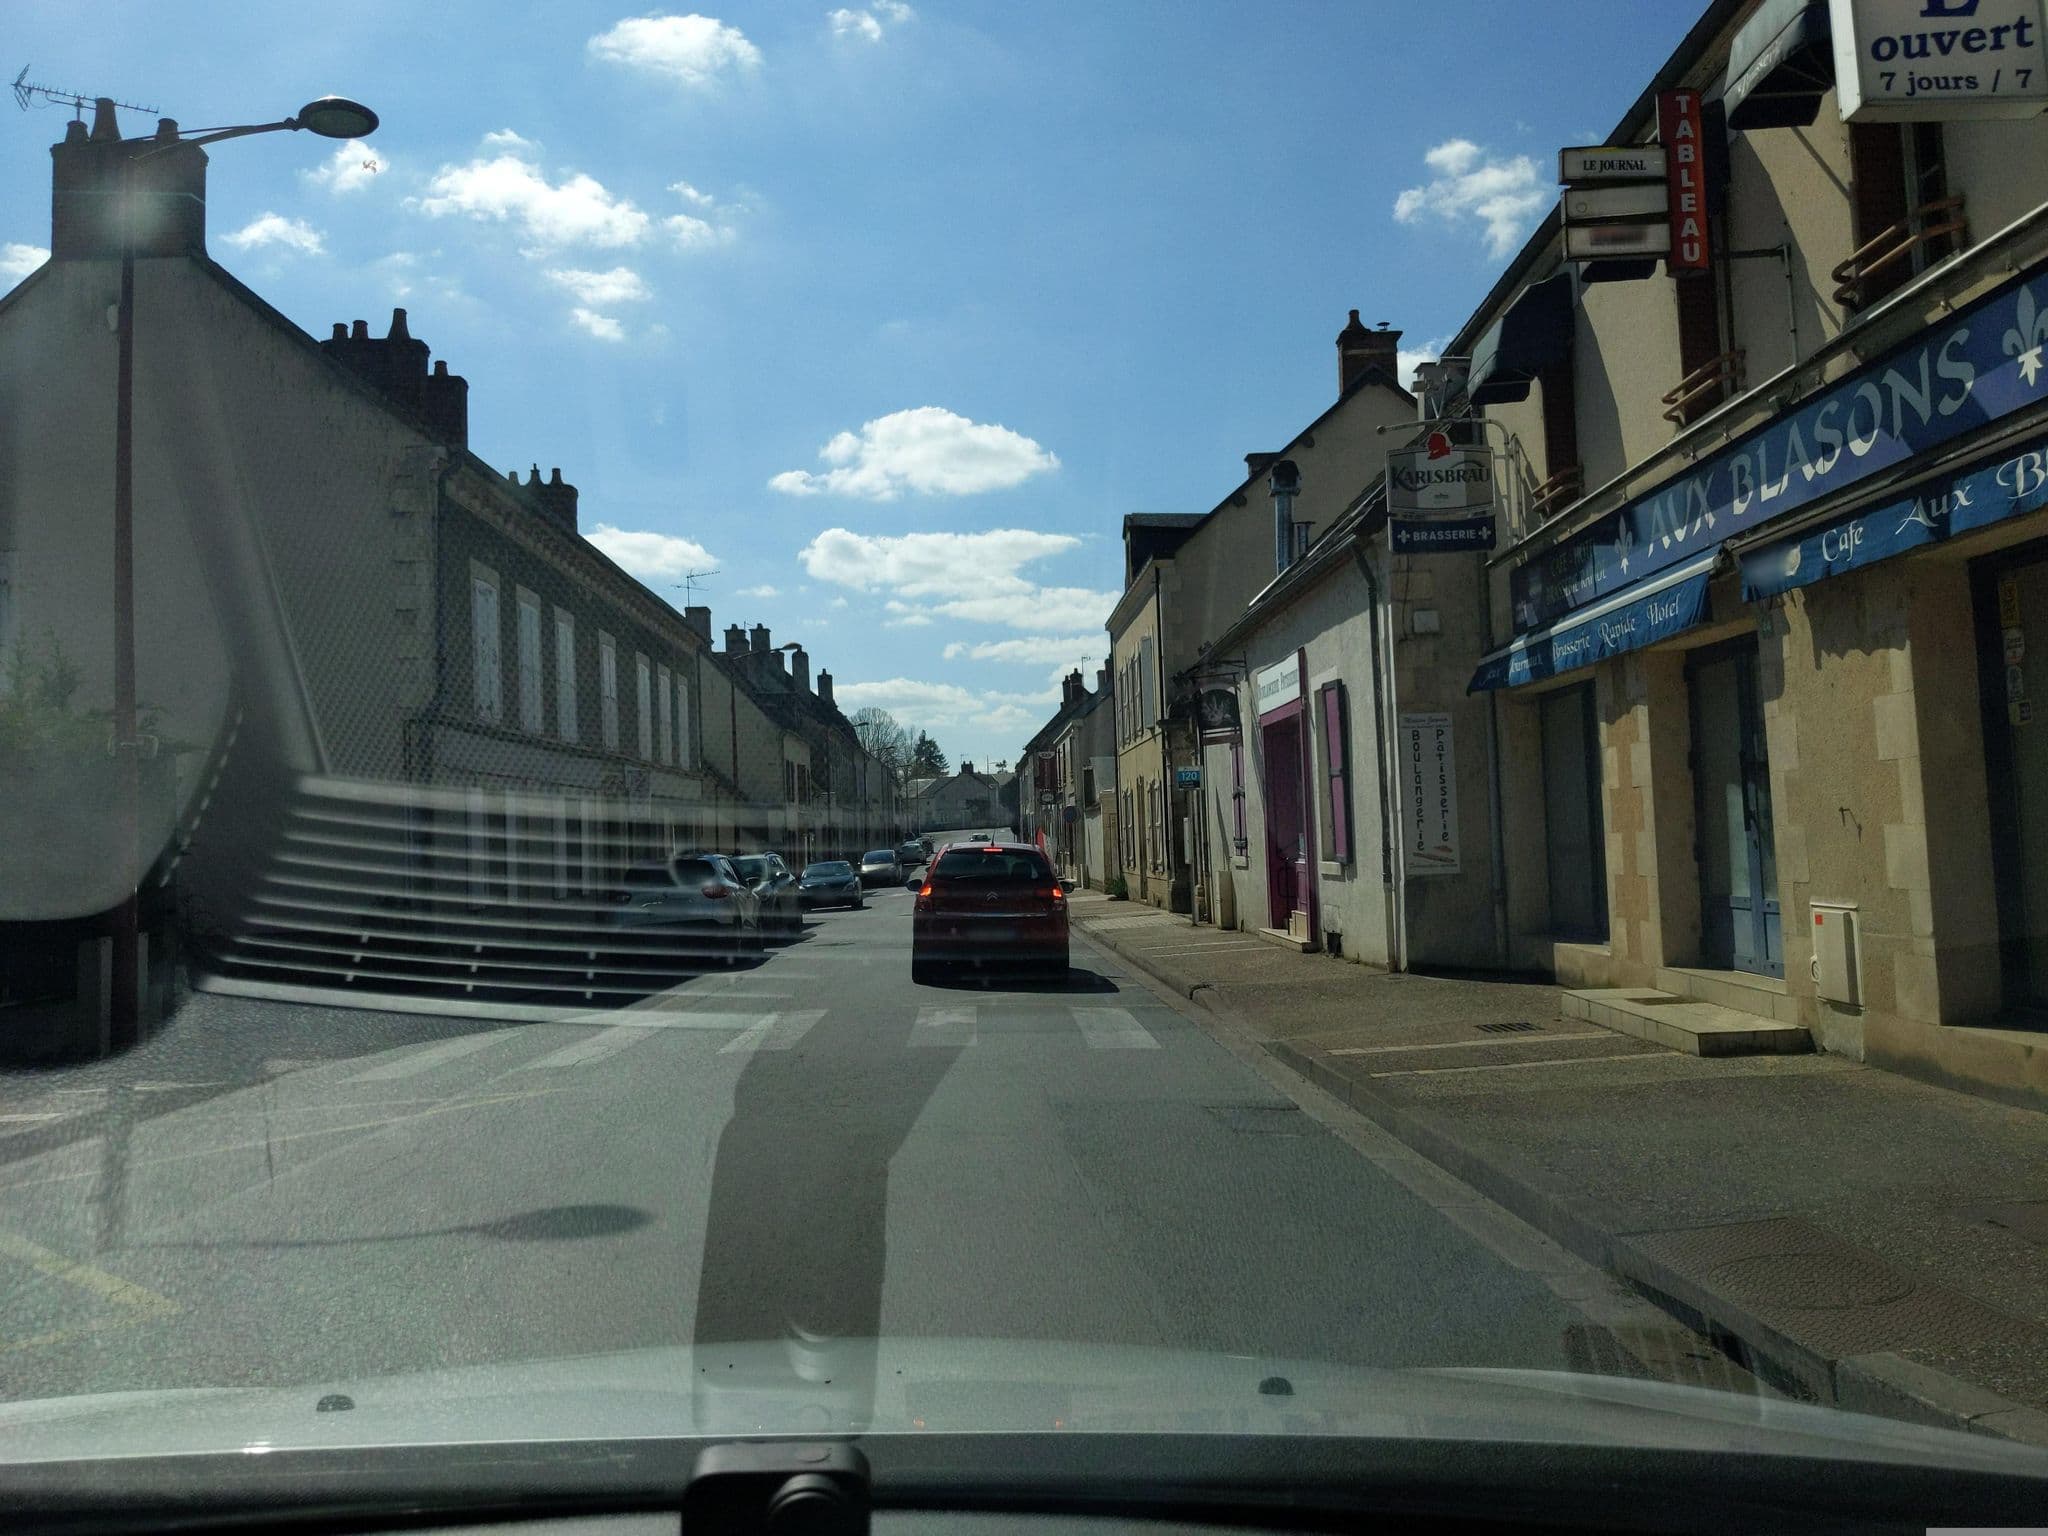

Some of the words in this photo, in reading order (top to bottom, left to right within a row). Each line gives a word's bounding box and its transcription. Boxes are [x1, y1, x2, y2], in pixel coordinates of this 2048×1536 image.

[1871, 15, 2034, 62] ouvert
[1880, 72, 1897, 91] 7
[1906, 72, 1979, 97] jours
[1992, 70, 2001, 93] /
[2016, 69, 2032, 88] 7
[1583, 160, 1597, 171] LE
[1599, 159, 1647, 173] JOURNAL
[1675, 95, 1700, 262] TABLEAU
[1648, 472, 1716, 558] AUX
[1728, 328, 1975, 516] BLASONS
[1412, 528, 1477, 541] BRASSERIE
[1822, 519, 1863, 562] Cafe
[1895, 484, 1974, 535] Aux
[1552, 632, 1591, 660] Brasserie
[1600, 612, 1636, 648] Rapide
[1647, 593, 1681, 626] Hotel
[1181, 771, 1198, 781] 120
